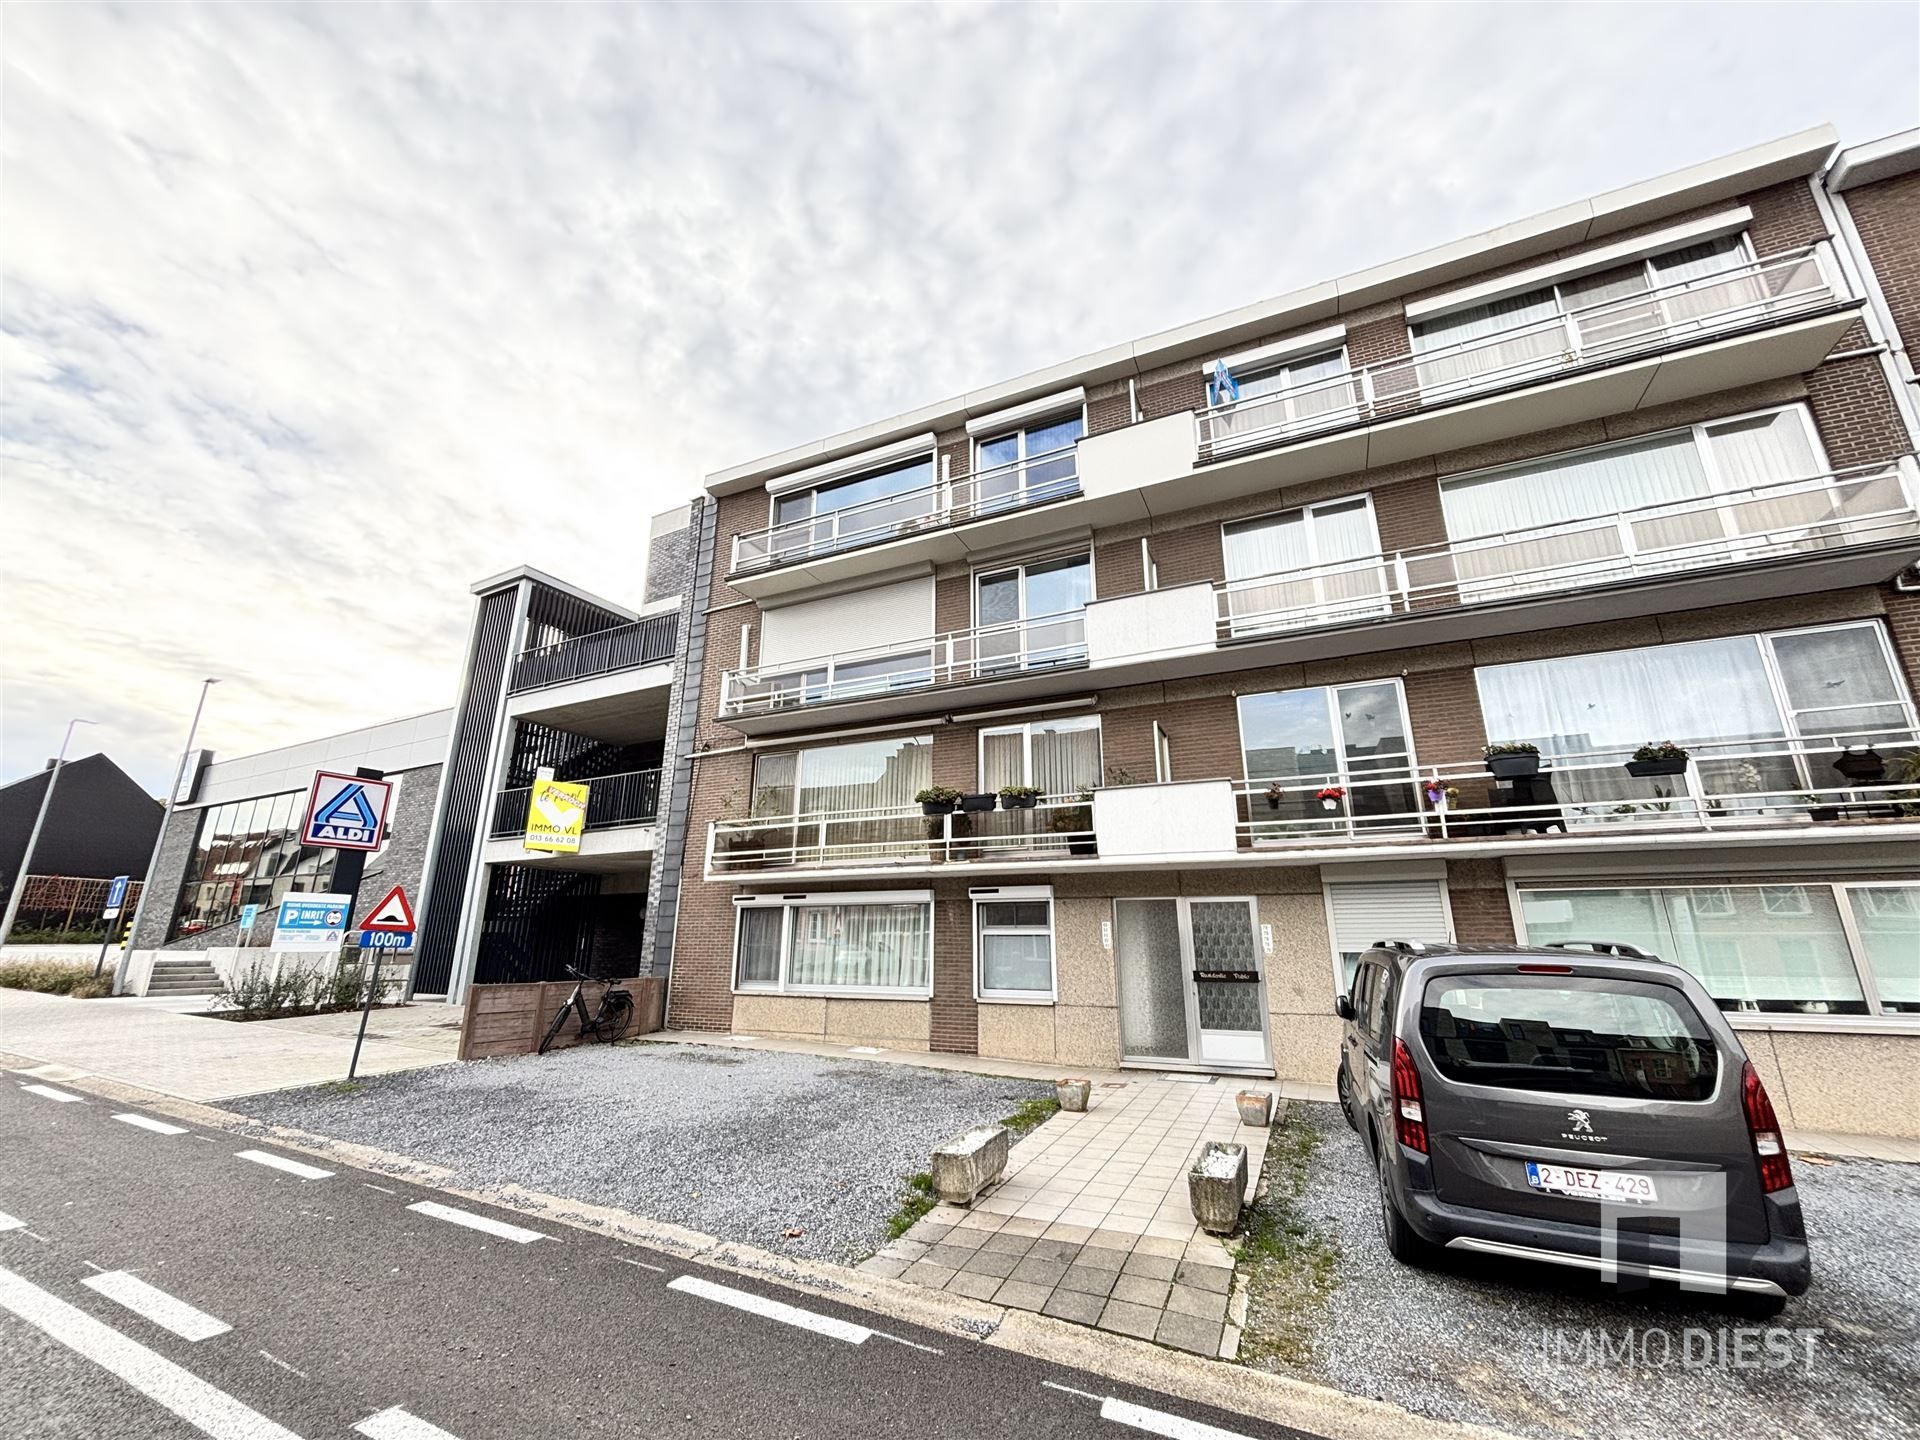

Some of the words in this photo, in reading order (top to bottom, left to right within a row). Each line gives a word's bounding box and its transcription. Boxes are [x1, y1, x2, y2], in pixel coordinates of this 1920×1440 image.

[317, 826, 371, 842] ALDI
[531, 823, 561, 833] IMMO
[564, 826, 577, 835] VL
[284, 909, 299, 924] P
[301, 910, 326, 920] INRIT
[369, 932, 406, 947] 100m
[1561, 1133, 1608, 1142] PEUGEOT
[1531, 1175, 1539, 1184] B
